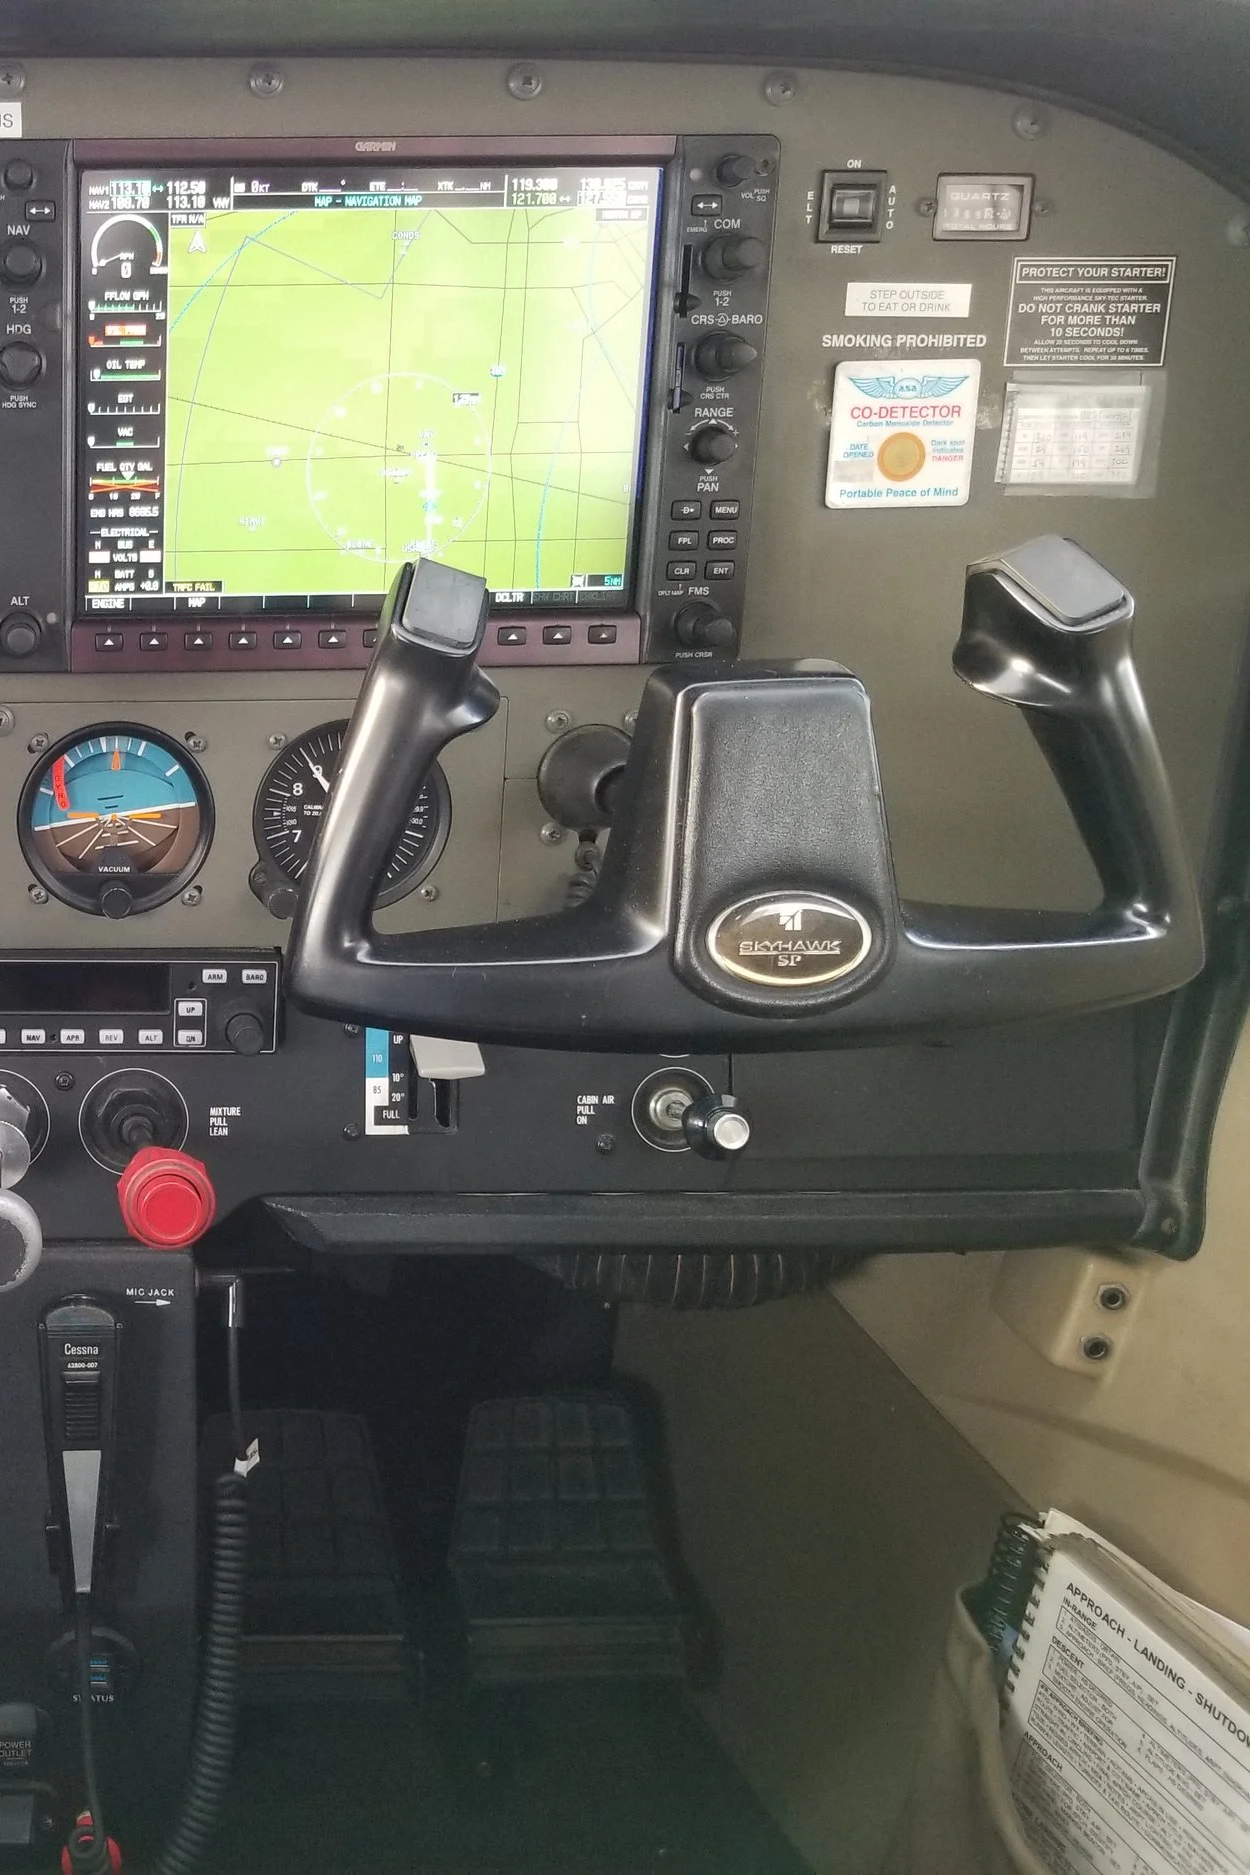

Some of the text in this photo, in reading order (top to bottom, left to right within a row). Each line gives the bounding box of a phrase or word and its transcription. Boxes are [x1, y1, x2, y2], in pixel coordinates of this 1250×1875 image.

[847, 160, 861, 168] ON
[315, 195, 422, 206] MAP NAVIGATION MAP
[8, 225, 30, 235] NAV
[831, 245, 862, 253] RESET
[1022, 268, 1166, 277] PROTECT YOUR STARTER!
[870, 290, 944, 299] STEP OUTSIDE
[862, 302, 950, 312] TO EAT OR DRINK
[1018, 304, 1160, 312] DO NOT CRANK STARTER
[1041, 316, 1135, 324] FOR MORE THAN
[1051, 327, 1124, 336] 10 SECONDS!
[822, 335, 986, 347] SMOKING PROHIBITED
[695, 408, 734, 417] RANGE
[851, 406, 961, 419] CO-DETECTOR
[840, 488, 958, 498] Portable Peace of Mind
[740, 941, 842, 952] SKYHAWK
[578, 1096, 614, 1104] CABIN AIR
[210, 1107, 240, 1116] MIXTURE
[383, 1110, 400, 1118] FULL
[577, 1106, 595, 1114] PULL
[210, 1116, 227, 1126] PULL
[577, 1116, 587, 1124] ON
[210, 1126, 228, 1136] LEAN
[126, 1288, 144, 1296] MIC
[65, 1344, 98, 1354] Cessna
[1067, 1582, 1125, 1638] APPROACH
[1133, 1639, 1185, 1690] LANDING
[1052, 1637, 1085, 1669] DESCENT
